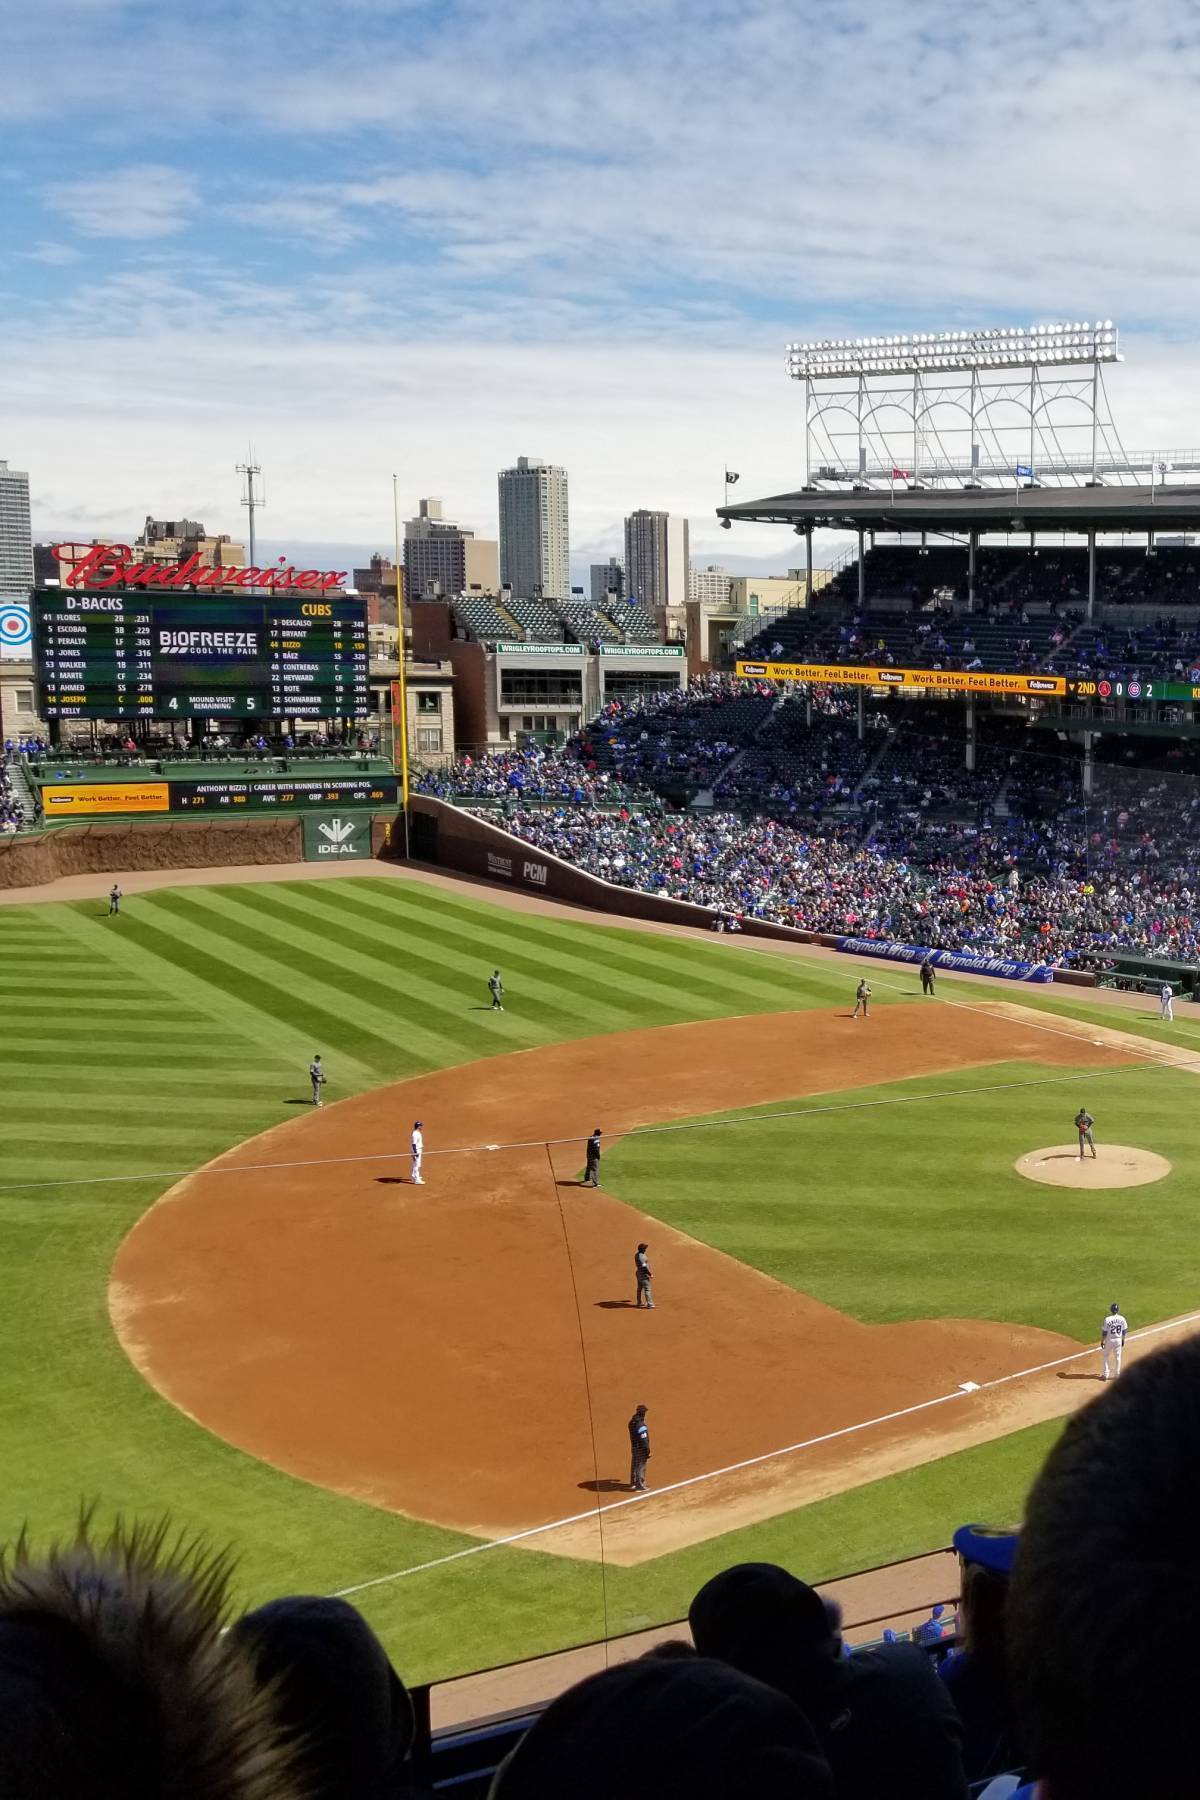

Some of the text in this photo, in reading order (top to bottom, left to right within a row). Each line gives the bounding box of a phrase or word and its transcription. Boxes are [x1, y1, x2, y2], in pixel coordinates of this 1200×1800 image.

[51, 542, 348, 590] Budweiser
[66, 597, 123, 610] D-BACKS
[301, 604, 332, 616] CUBS
[501, 644, 580, 653] WRIGLEYROOFTOPS.COM
[604, 647, 679, 655] WRIGLEYROOFTOPS.COM
[773, 667, 871, 680] Work Better. Feel Better.
[912, 674, 1020, 688] Work Better. Feel Better.
[1029, 680, 1054, 689] Fellowes
[1078, 682, 1153, 696] 2ND 0 2
[169, 698, 178, 709] 4
[246, 698, 255, 709] 5
[318, 844, 356, 853] IDEAL
[523, 862, 547, 882] PCM
[843, 939, 915, 960] Reynolds Wrap
[938, 952, 1017, 975] Reynolds Wrap
[1111, 1325, 1121, 1334] 28
